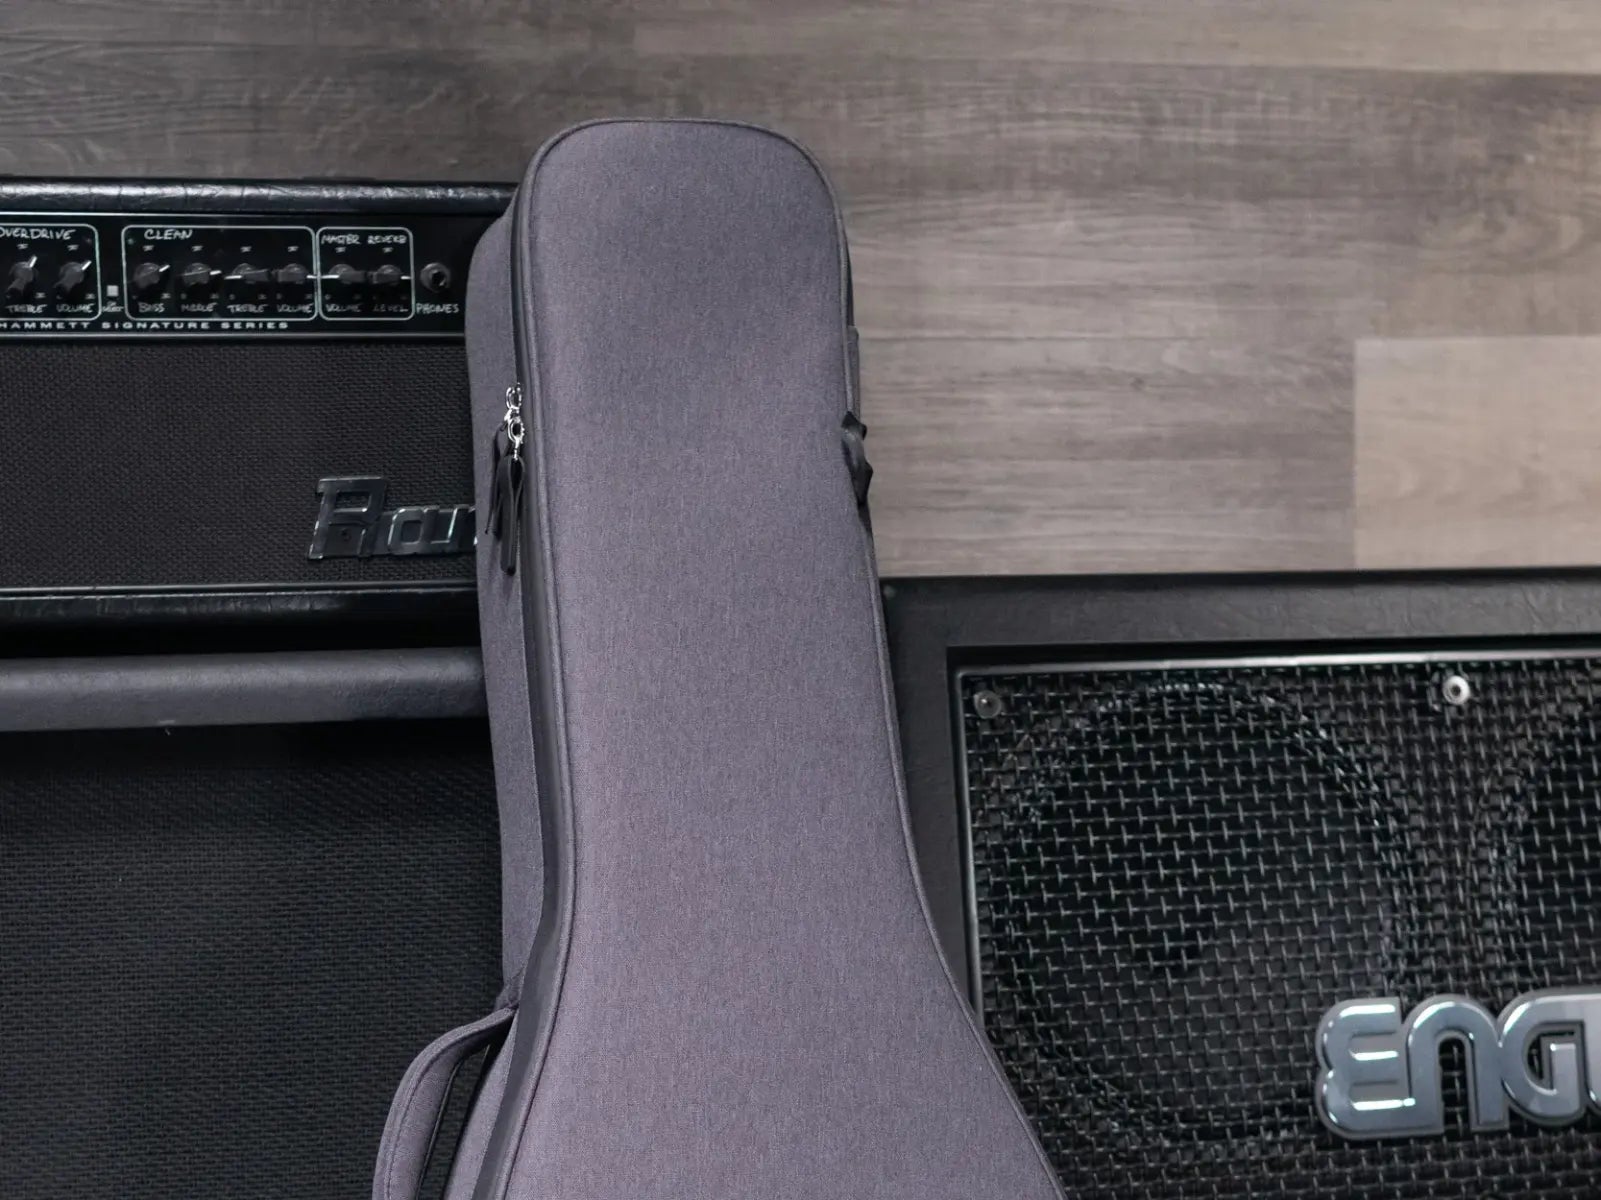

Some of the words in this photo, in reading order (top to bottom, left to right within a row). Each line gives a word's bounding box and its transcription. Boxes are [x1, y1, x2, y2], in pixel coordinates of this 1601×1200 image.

[143, 228, 193, 241] CLEAN
[320, 234, 361, 245] MASTER
[367, 234, 407, 245] REVERB
[416, 302, 460, 314] PHONES
[101, 321, 210, 330] SIGNATURE
[221, 321, 288, 330] SERIES
